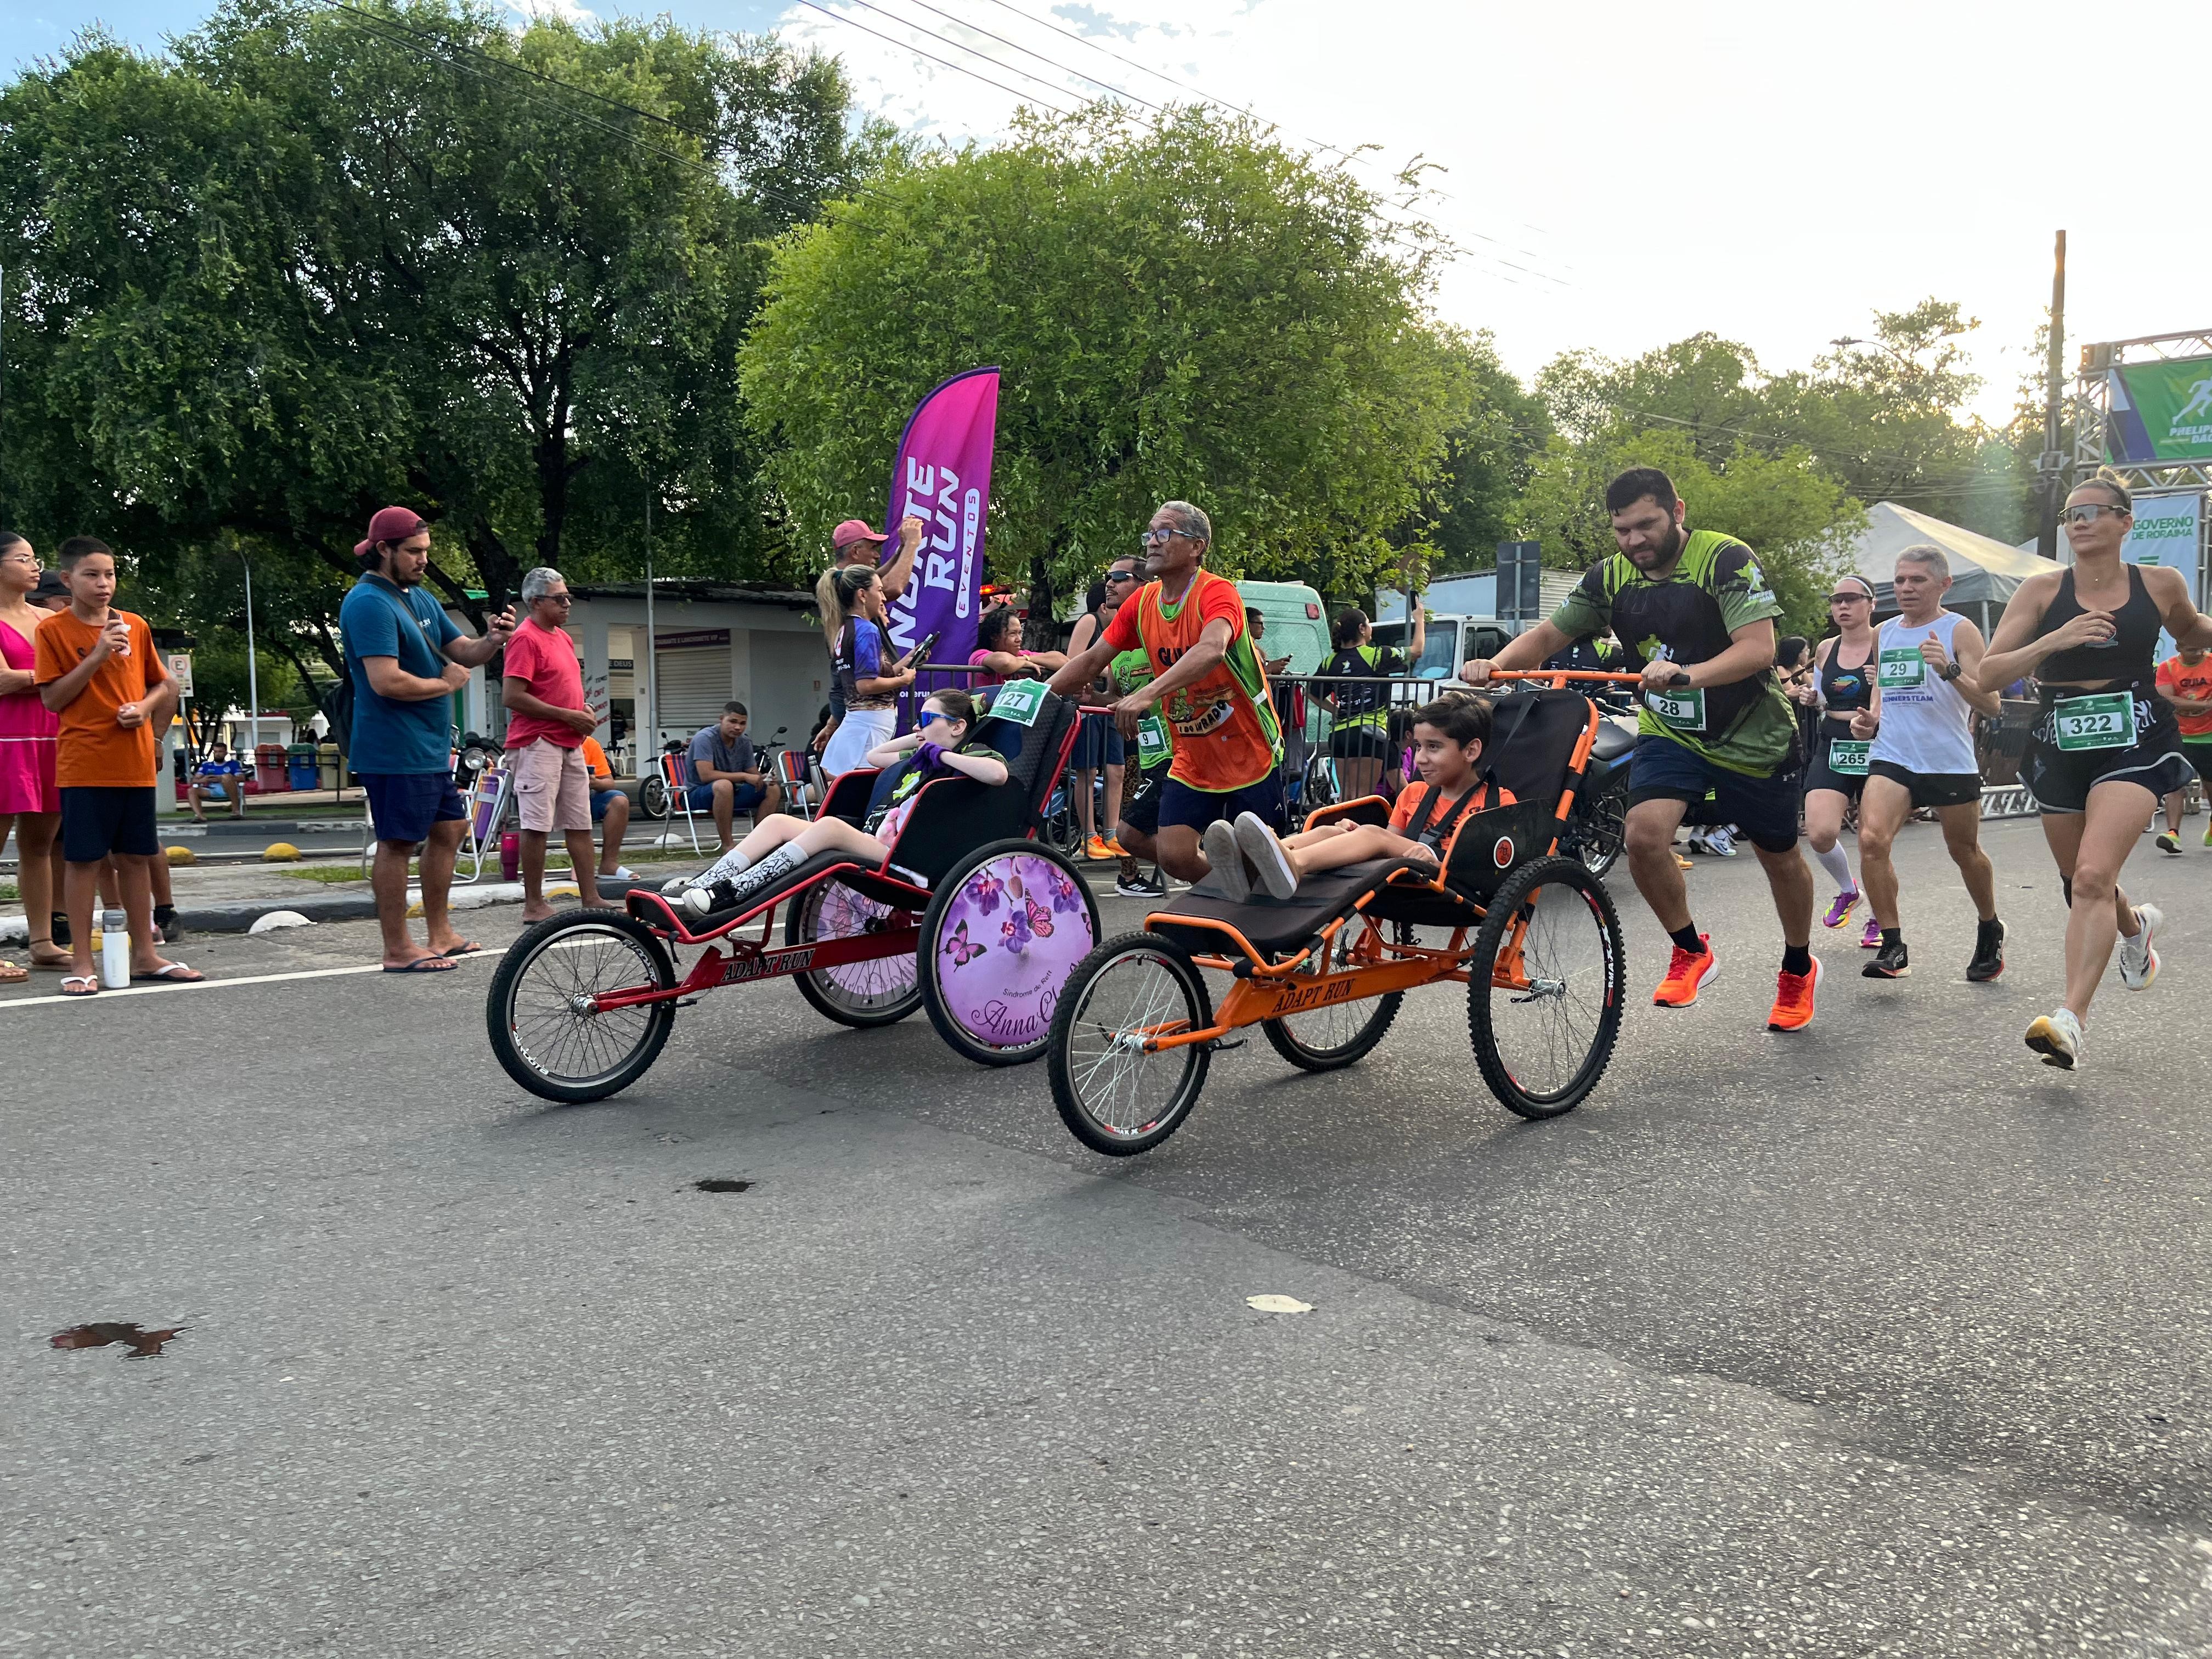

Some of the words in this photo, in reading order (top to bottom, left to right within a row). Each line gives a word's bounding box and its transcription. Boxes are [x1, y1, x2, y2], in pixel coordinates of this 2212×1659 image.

[924, 466, 960, 591] RUN
[2132, 516, 2193, 530] GOVERNO
[2132, 532, 2144, 540] DE
[2146, 528, 2192, 539] RORAIMA
[958, 495, 976, 611] EVENTOS
[1158, 646, 1190, 667] GUI
[1889, 663, 1906, 676] 29
[2180, 677, 2208, 687] GUIA
[998, 692, 1025, 707] 127
[1659, 699, 1680, 715] 28
[2070, 715, 2112, 734] 322
[1142, 733, 1149, 744] 9
[1839, 754, 1866, 764] 265
[721, 955, 778, 981] ADAPT
[777, 948, 816, 973] RUN
[1272, 985, 1323, 1013] ADAPT
[1322, 978, 1356, 1001] RUN
[970, 1000, 1038, 1036] Anna
